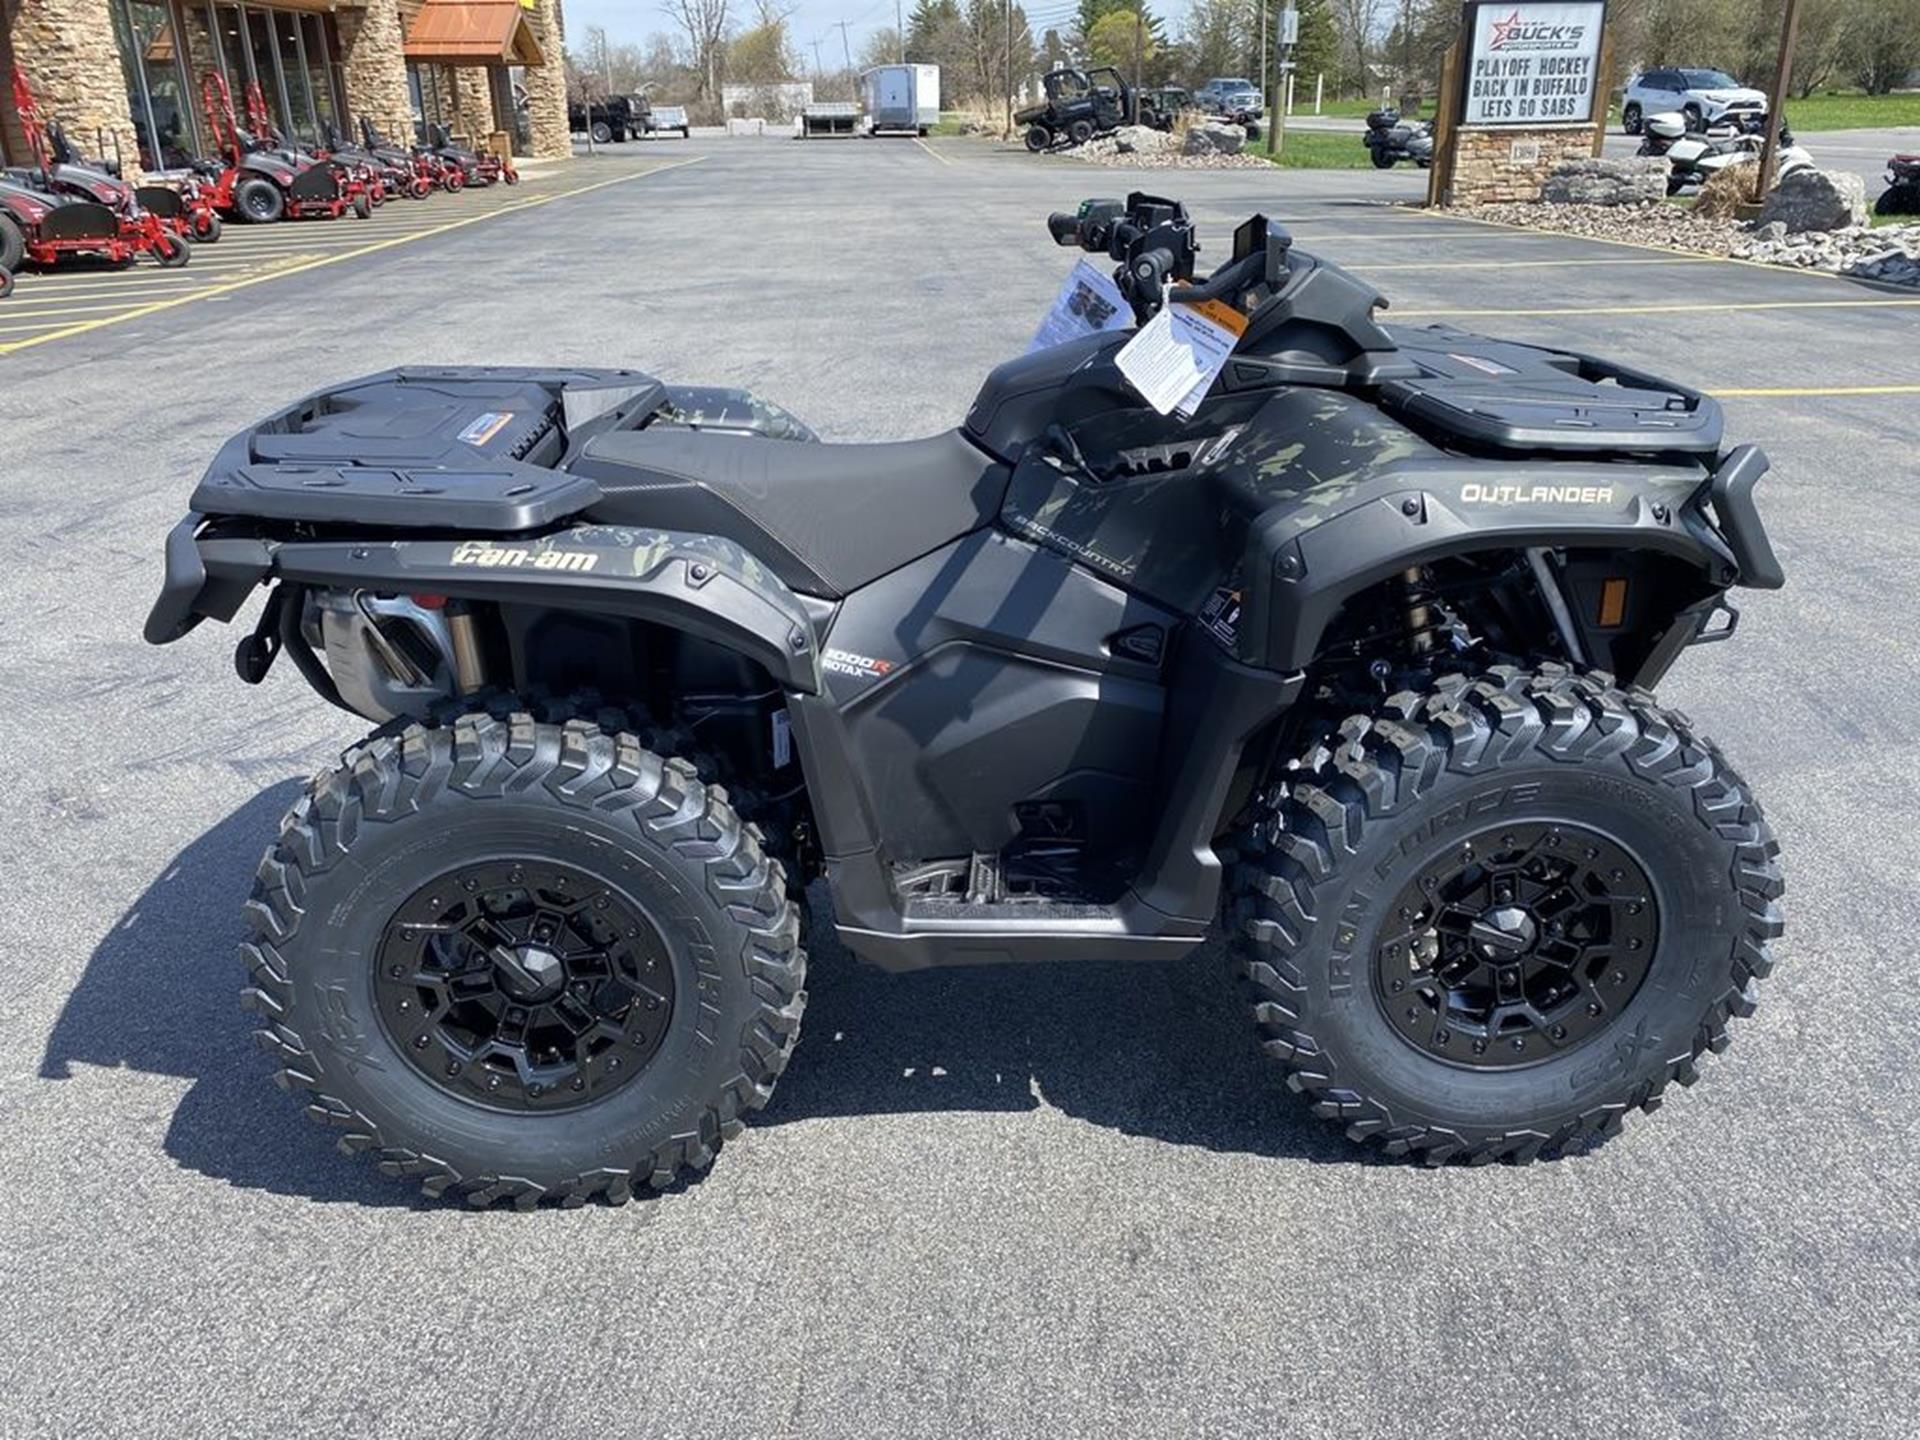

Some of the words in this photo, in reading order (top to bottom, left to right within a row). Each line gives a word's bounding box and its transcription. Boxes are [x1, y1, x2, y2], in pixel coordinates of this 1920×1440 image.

[1505, 25, 1585, 41] BUCK'S
[1475, 58, 1531, 77] PLAYOFF
[1539, 56, 1590, 75] HOCKEY
[1473, 79, 1508, 97] BACK
[1513, 78, 1529, 96] IN
[1533, 77, 1588, 96] BUFFALO
[1481, 100, 1513, 118] LETS
[1518, 100, 1536, 117] GO
[1541, 98, 1576, 116] SABS
[1460, 484, 1614, 504] OUTLANDER
[1014, 515, 1133, 576] BACKCOUNTRY
[822, 659, 863, 678] ROTAX
